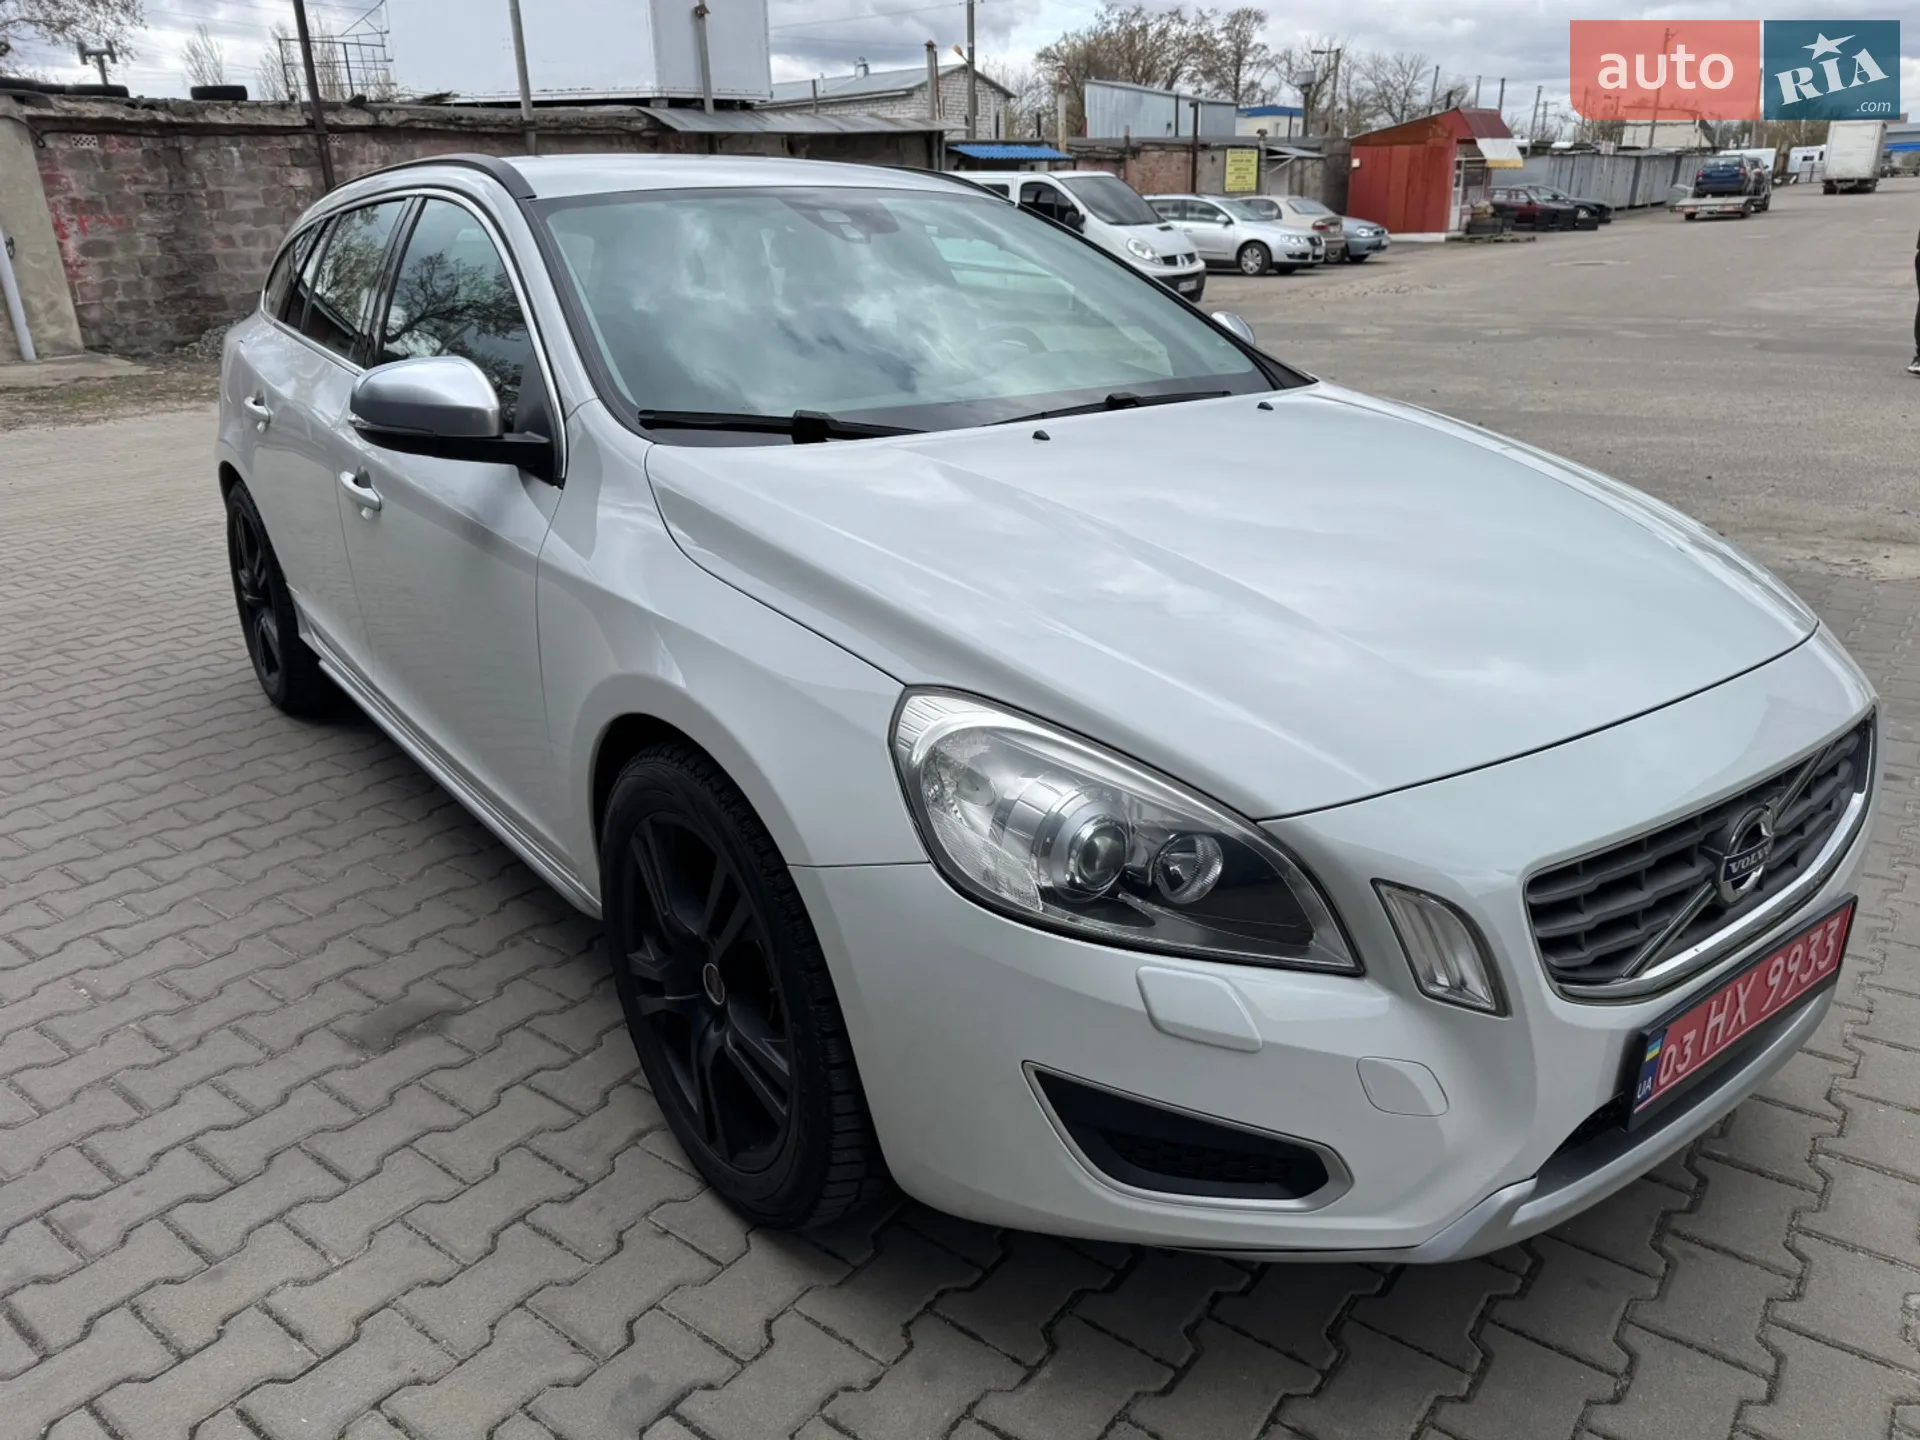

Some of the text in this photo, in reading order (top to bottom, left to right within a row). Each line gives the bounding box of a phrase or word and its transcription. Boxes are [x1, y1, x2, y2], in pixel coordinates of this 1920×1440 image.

[1659, 917, 1840, 1085] 03 HX 9933
[1637, 1077, 1652, 1099] UA
